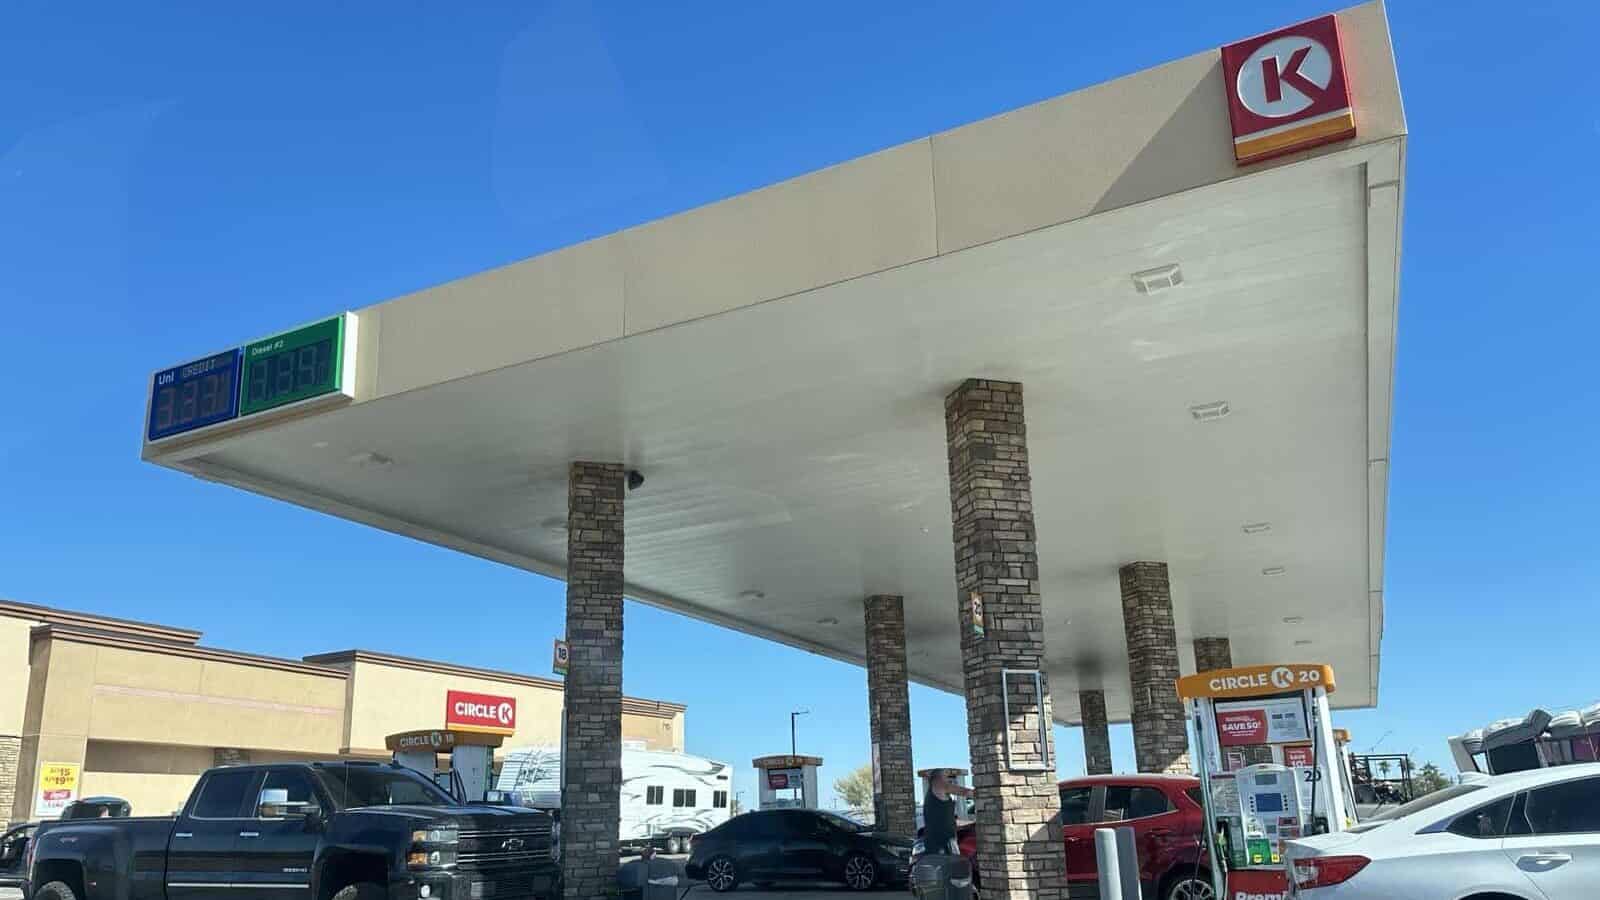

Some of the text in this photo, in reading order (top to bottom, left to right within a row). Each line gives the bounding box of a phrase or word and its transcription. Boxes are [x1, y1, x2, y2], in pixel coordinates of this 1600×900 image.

[1258, 43, 1330, 106] K
[251, 343, 273, 356] Diesel
[1209, 668, 1320, 691] CIRCLE K 20
[455, 702, 513, 722] CIRCLE K
[1222, 722, 1247, 731] SAVE
[400, 735, 430, 746] CIRCLE
[1304, 770, 1321, 782] 20
